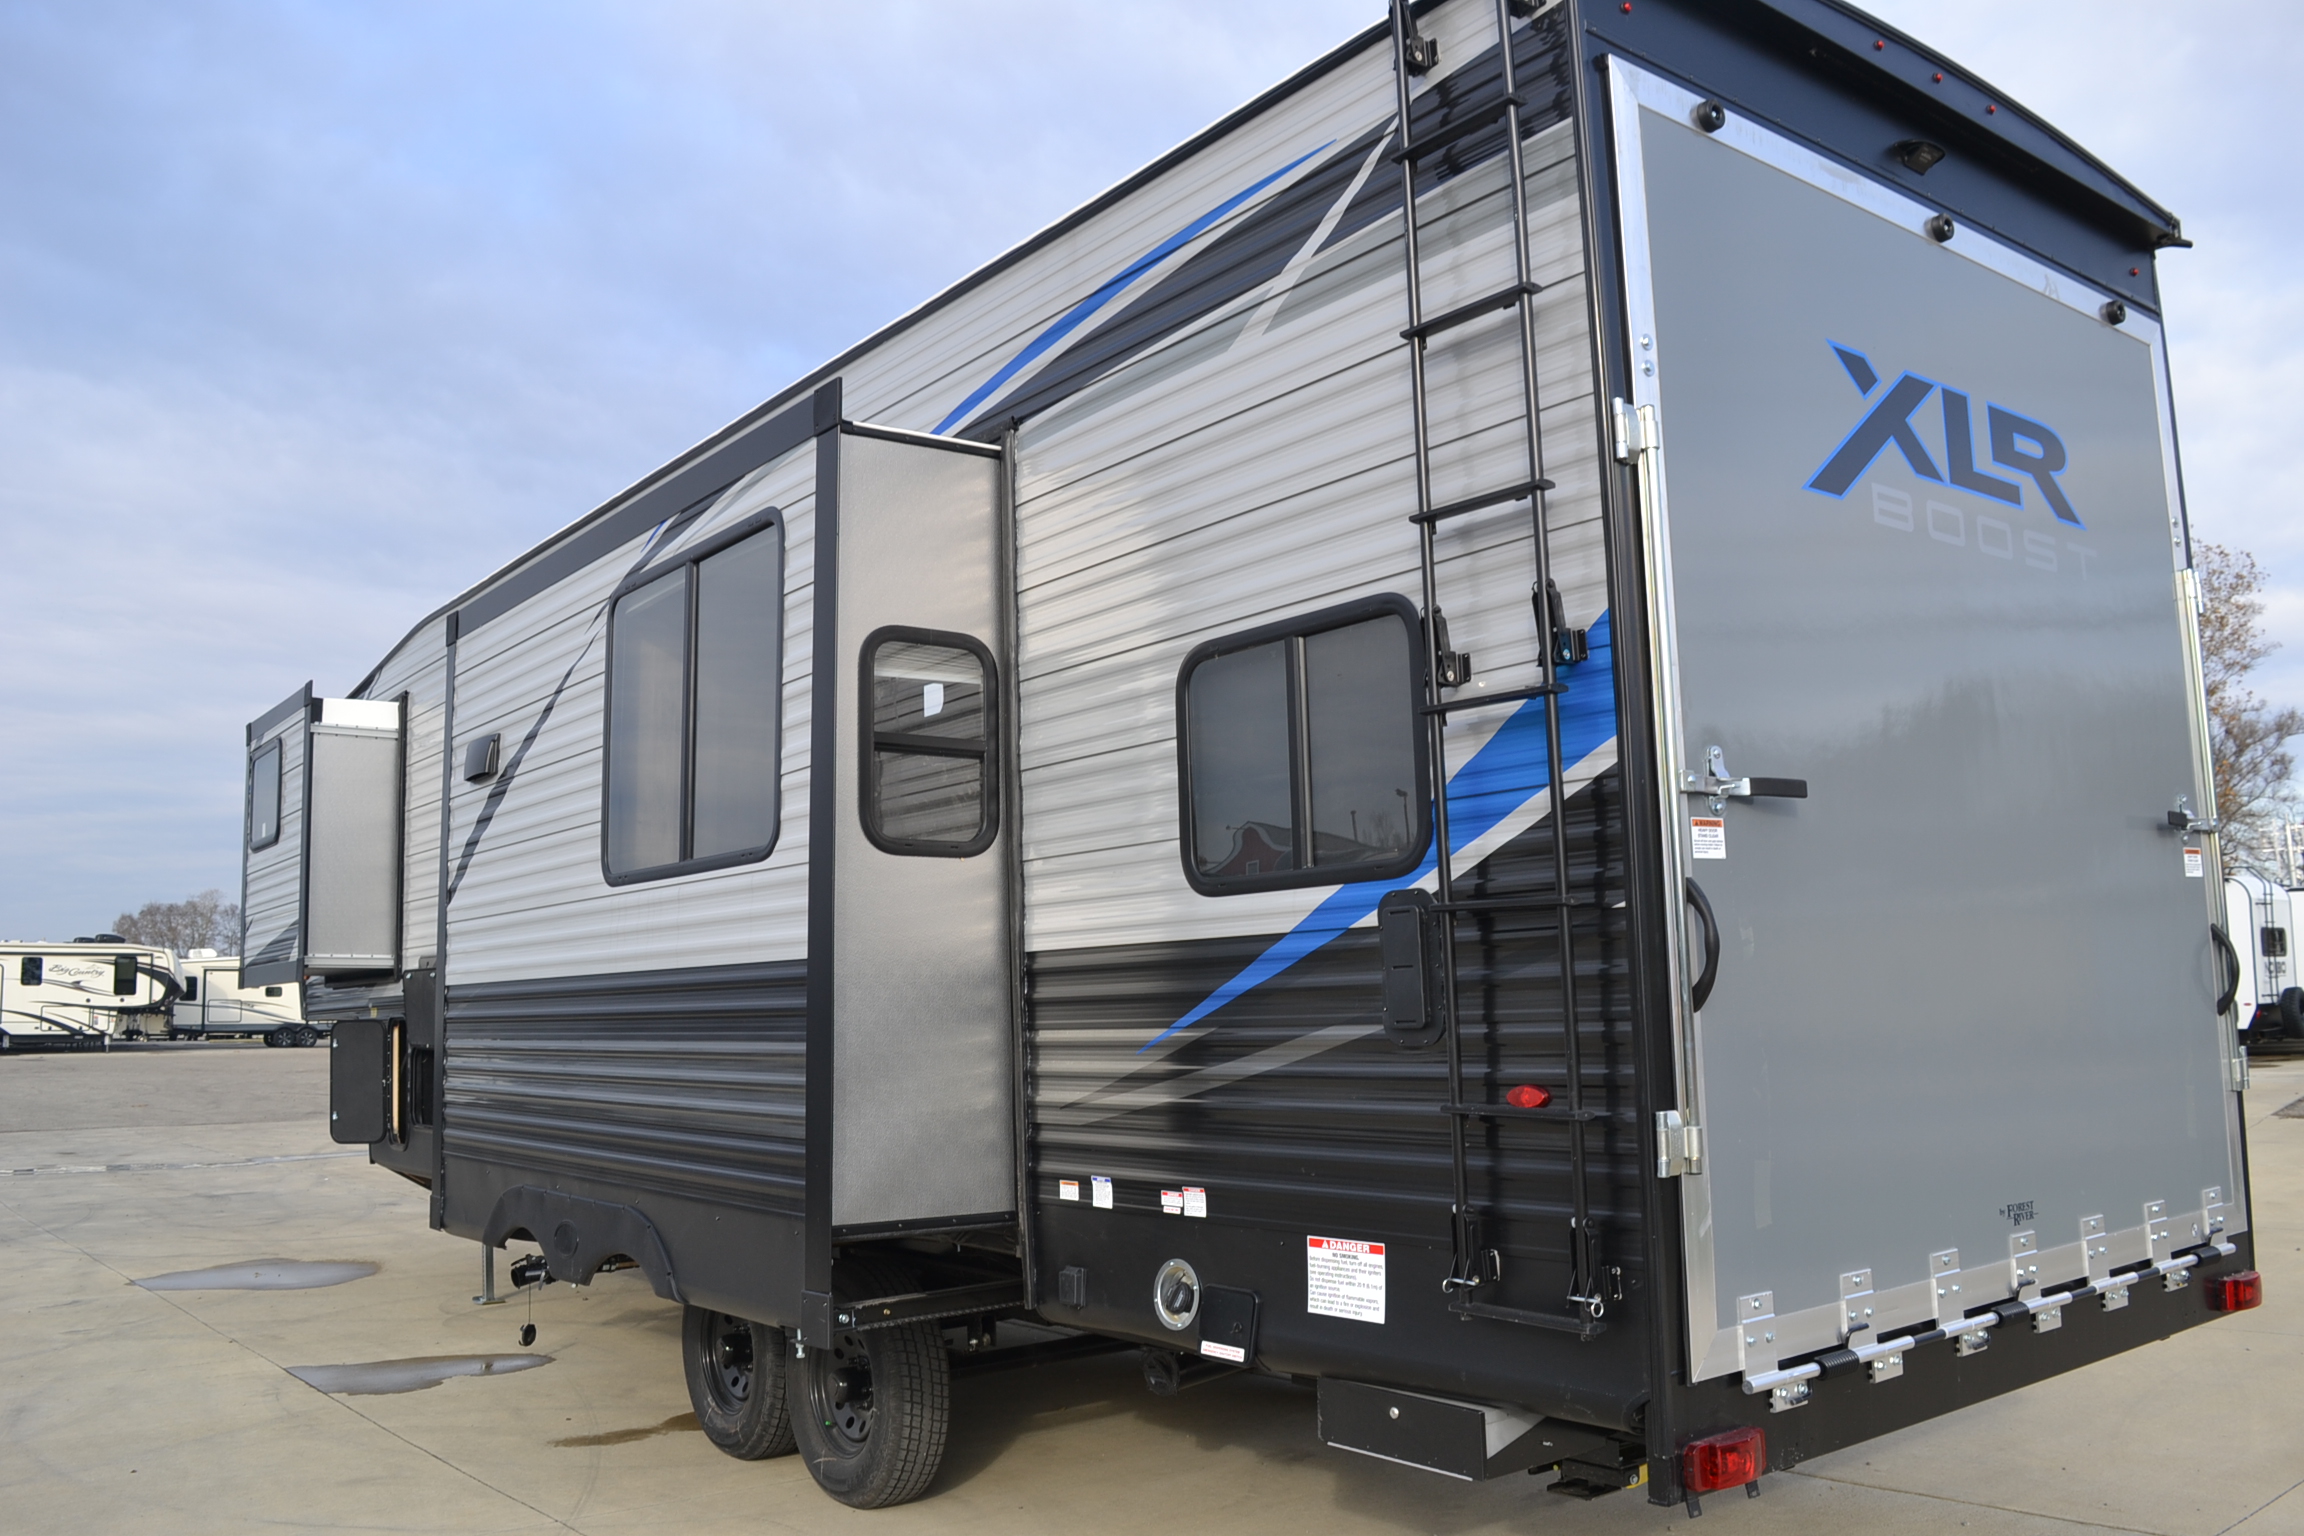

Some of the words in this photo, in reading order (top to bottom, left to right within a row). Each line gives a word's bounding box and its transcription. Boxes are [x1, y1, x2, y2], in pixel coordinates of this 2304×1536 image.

[1801, 337, 2088, 531] XLR
[1871, 482, 2098, 581] BOOST
[48, 964, 70, 976] Big
[68, 967, 105, 978] Country
[2007, 1200, 2034, 1218] FOREST
[2013, 1211, 2034, 1226] RIVER
[1329, 1240, 1370, 1253] DANGER
